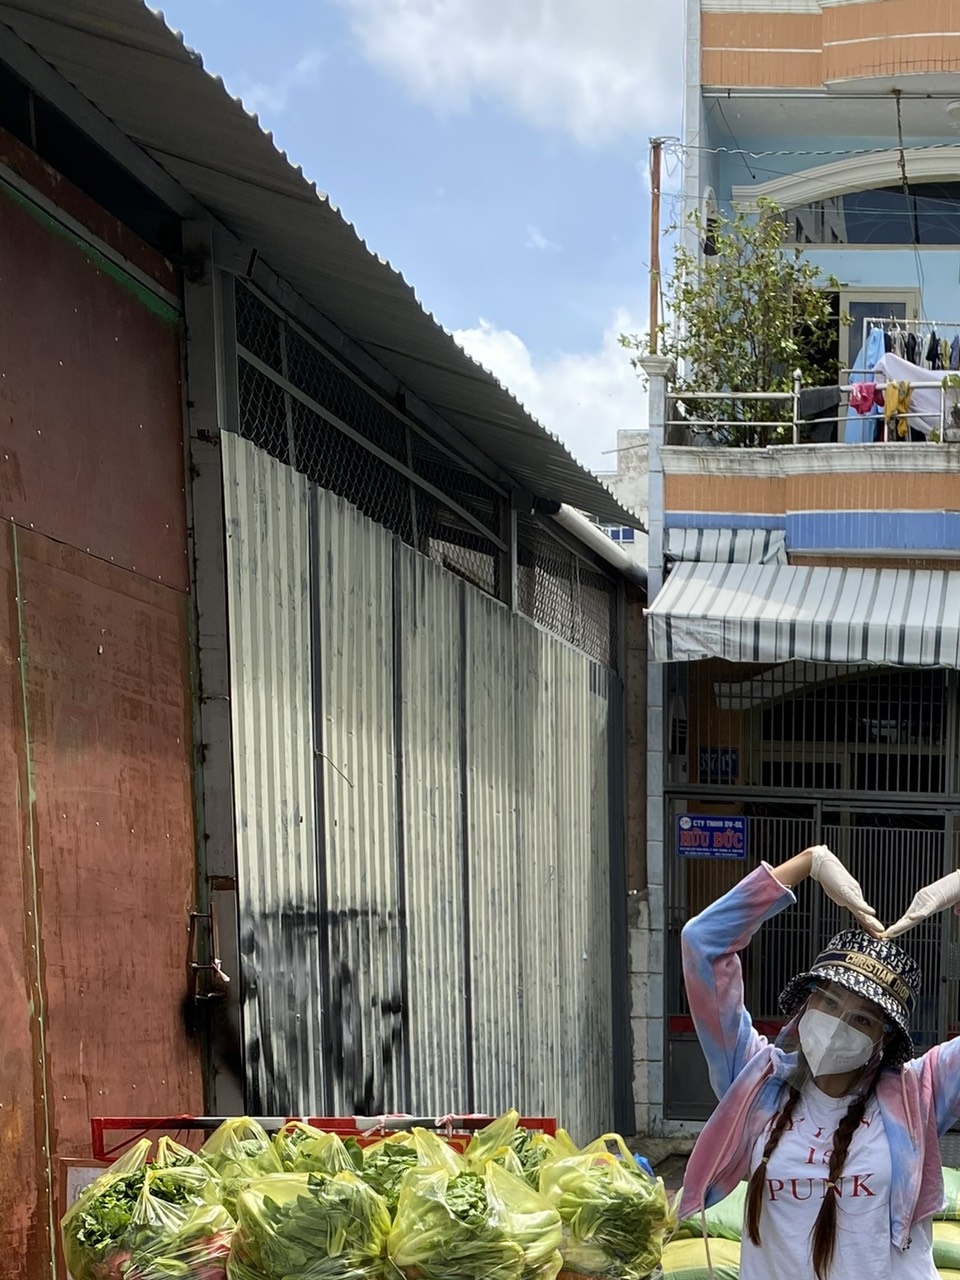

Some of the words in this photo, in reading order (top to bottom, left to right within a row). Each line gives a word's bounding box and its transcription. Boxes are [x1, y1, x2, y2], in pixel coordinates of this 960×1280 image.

[845, 953, 894, 985] CHRISTIAN
[892, 979, 910, 1003] DIOR
[766, 1173, 876, 1202] PUNK
